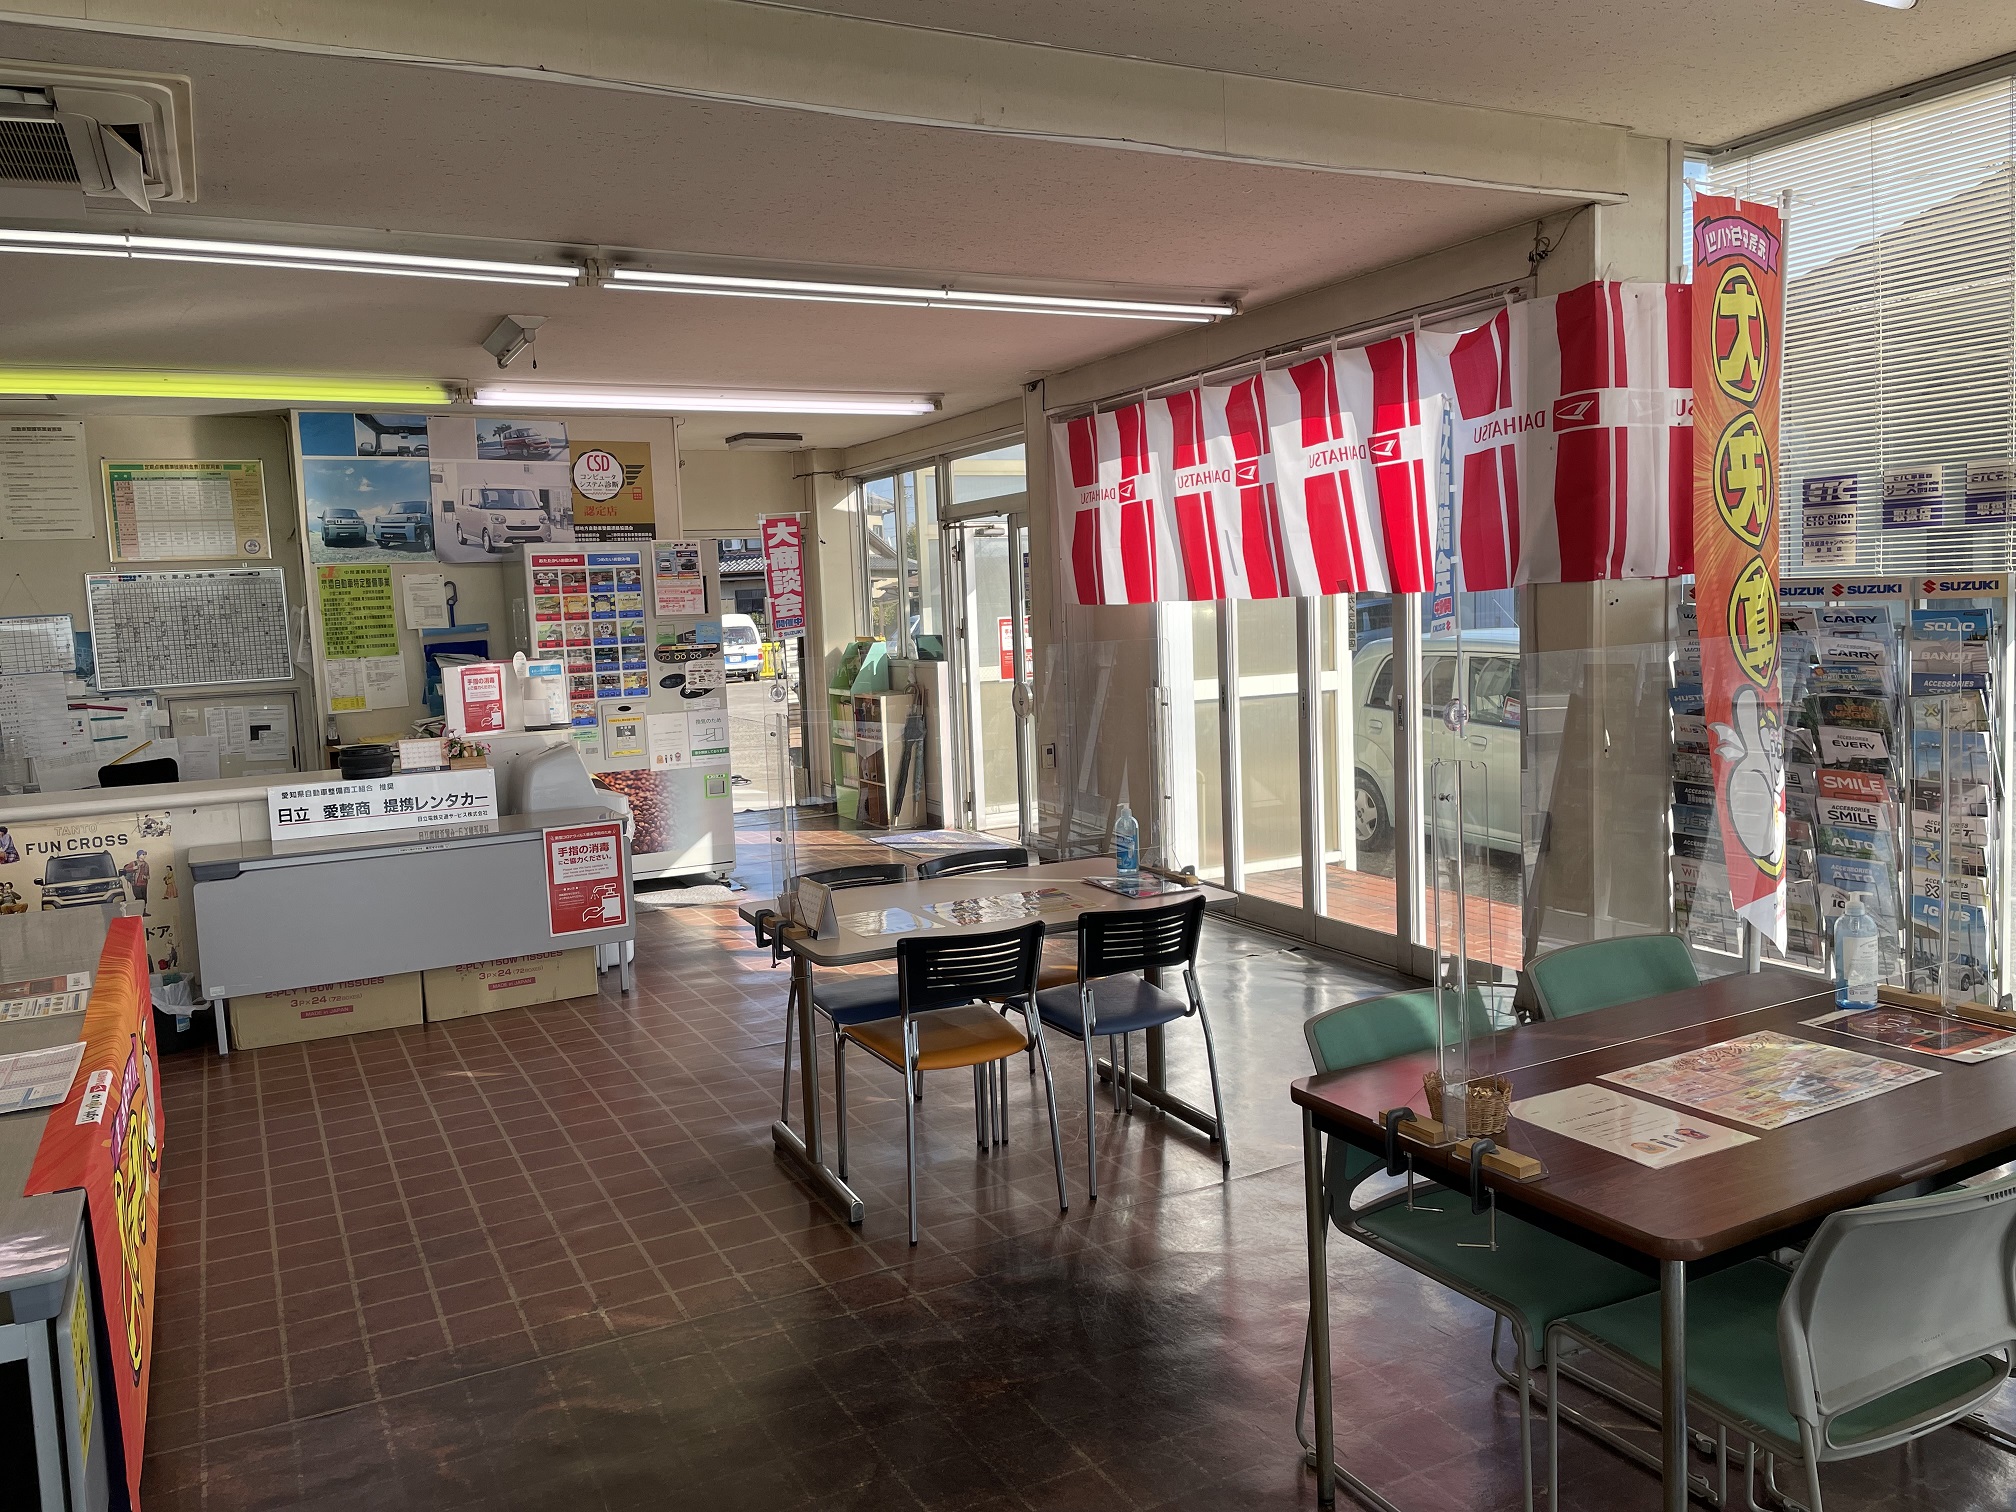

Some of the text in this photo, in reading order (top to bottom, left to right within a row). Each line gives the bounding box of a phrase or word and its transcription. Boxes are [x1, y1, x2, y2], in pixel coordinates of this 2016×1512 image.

[587, 455, 610, 472] CSD
[580, 481, 619, 489] システム診断
[1809, 478, 1854, 502] ETC
[584, 505, 617, 517] 認定店
[1806, 513, 1854, 527] ETC SHOP
[767, 521, 802, 618] 大商談会
[1780, 586, 1825, 596] SUZUK
[1847, 583, 1902, 595] SUZUKI
[1939, 580, 1999, 592] SUZUKI
[776, 617, 803, 629] 開催中
[1823, 615, 1878, 624] CARRY
[783, 629, 804, 637] SUZUKI
[1923, 622, 1975, 632] SOLIO
[1827, 648, 1880, 660] CARRY
[1921, 651, 1976, 660] BANDIT
[1923, 680, 1974, 688] ACCESSORIES
[1837, 734, 1869, 742] ACCESSORIES
[1832, 739, 1875, 750] EVERY
[1823, 775, 1881, 793] SMILE
[281, 782, 395, 800] 愛知県自動車整備商工組合 推奨
[278, 791, 488, 824] 日立 愛整商 提携レンタカー
[1831, 804, 1871, 813] ACCESSORIES
[417, 810, 488, 823] 日立電鉄交通サービス株式会社
[1827, 810, 1877, 825] SMILE
[54, 823, 98, 837] TANTO
[25, 833, 129, 856] FUN CROSS
[557, 841, 610, 858] 手指の消毒
[1831, 837, 1874, 851] ALTO
[558, 853, 612, 866] にご協力ください。
[1832, 871, 1875, 883] ALTO
[305, 1010, 322, 1018] MADE
[330, 1006, 350, 1015] JAPAN
